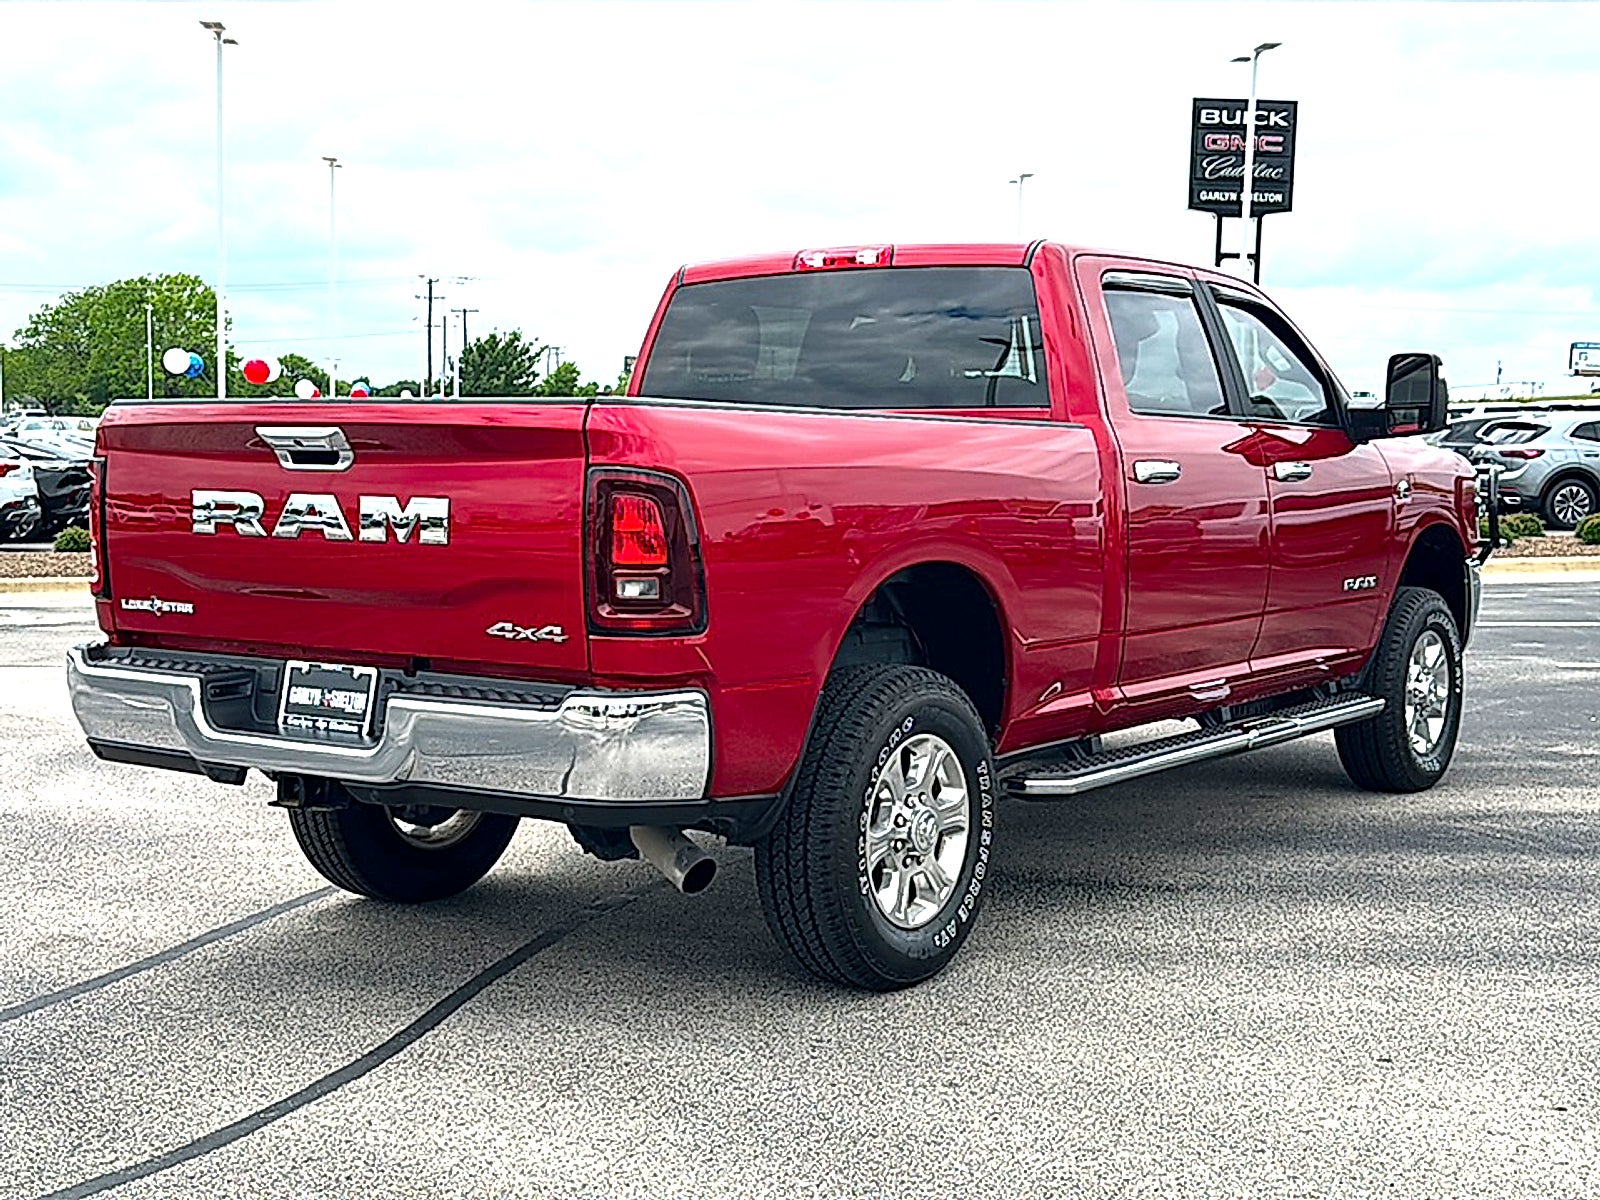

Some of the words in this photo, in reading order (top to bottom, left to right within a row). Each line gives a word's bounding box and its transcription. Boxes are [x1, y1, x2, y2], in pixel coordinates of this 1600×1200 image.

[1200, 109, 1290, 127] BUICK
[1204, 133, 1284, 152] GMC
[1200, 190, 1238, 202] GARLYN
[191, 489, 450, 545] RAM
